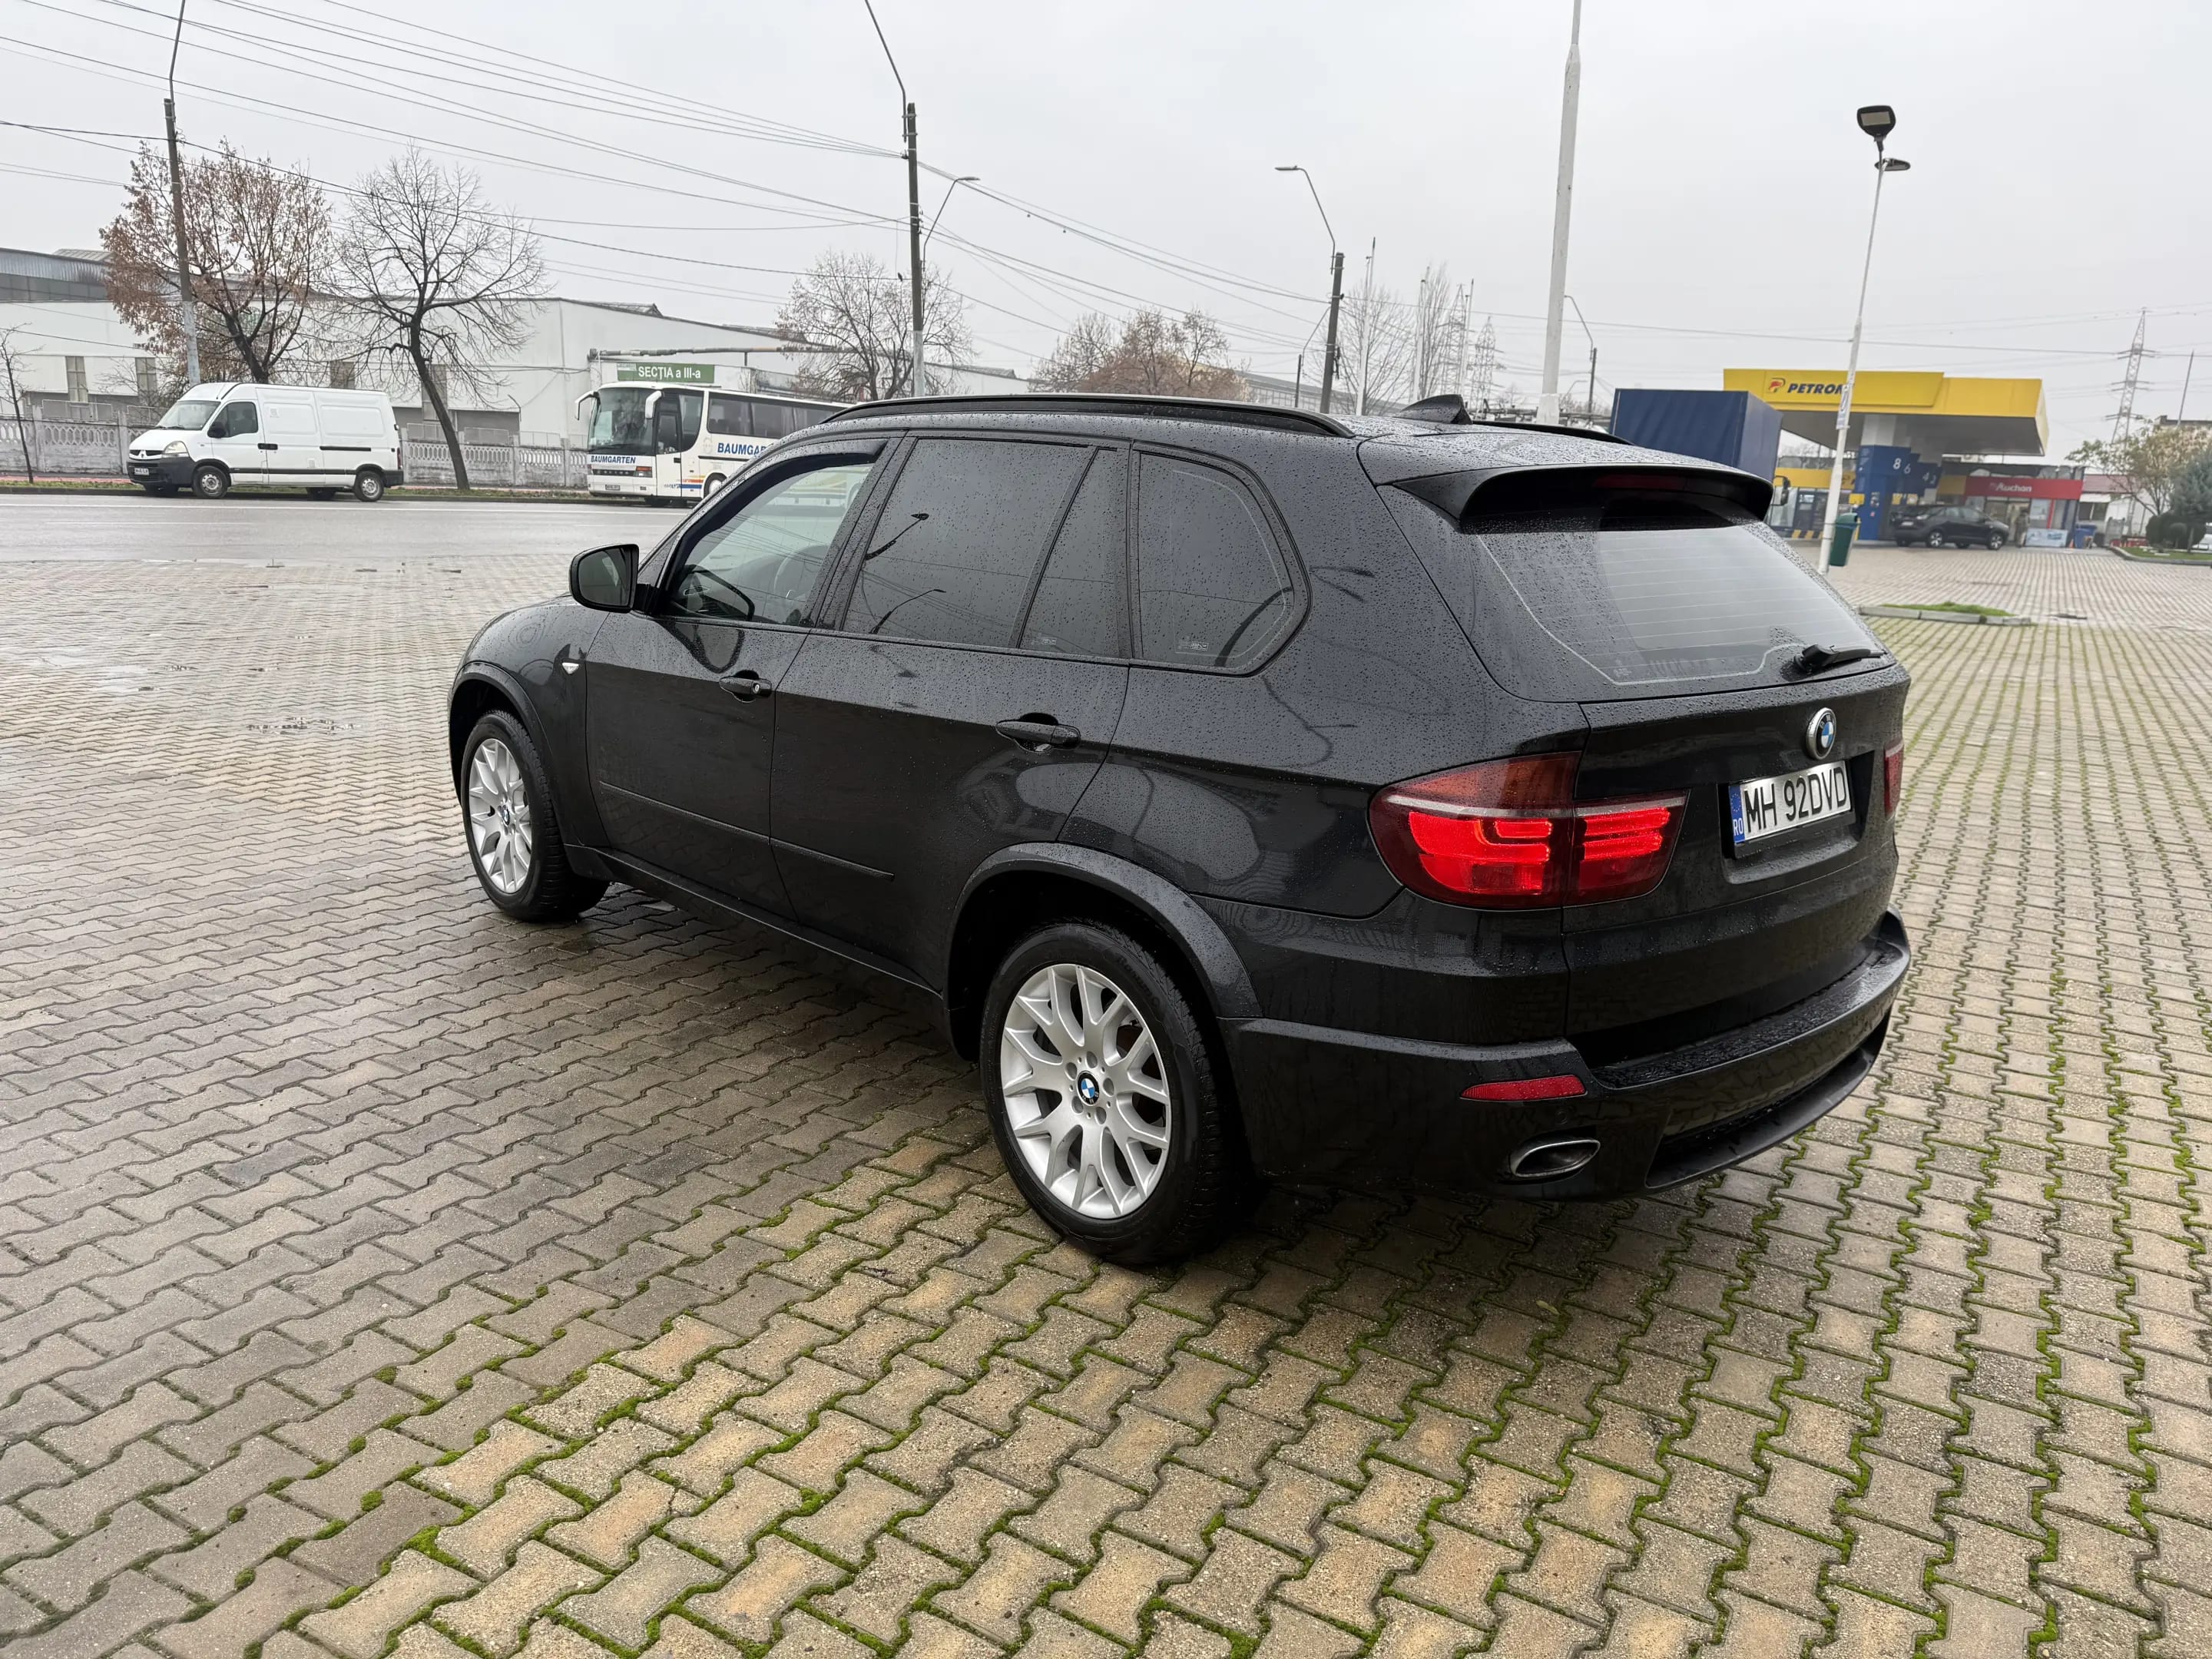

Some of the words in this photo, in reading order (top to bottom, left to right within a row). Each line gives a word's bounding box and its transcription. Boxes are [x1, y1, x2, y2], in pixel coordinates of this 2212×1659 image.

[675, 370, 681, 379] a
[684, 367, 701, 379] III-a
[591, 455, 636, 464] BAUMGARTEN
[1892, 458, 1902, 469] 8
[1903, 463, 1911, 474] 6
[1743, 783, 1777, 833] MH
[1733, 817, 1743, 836] RO
